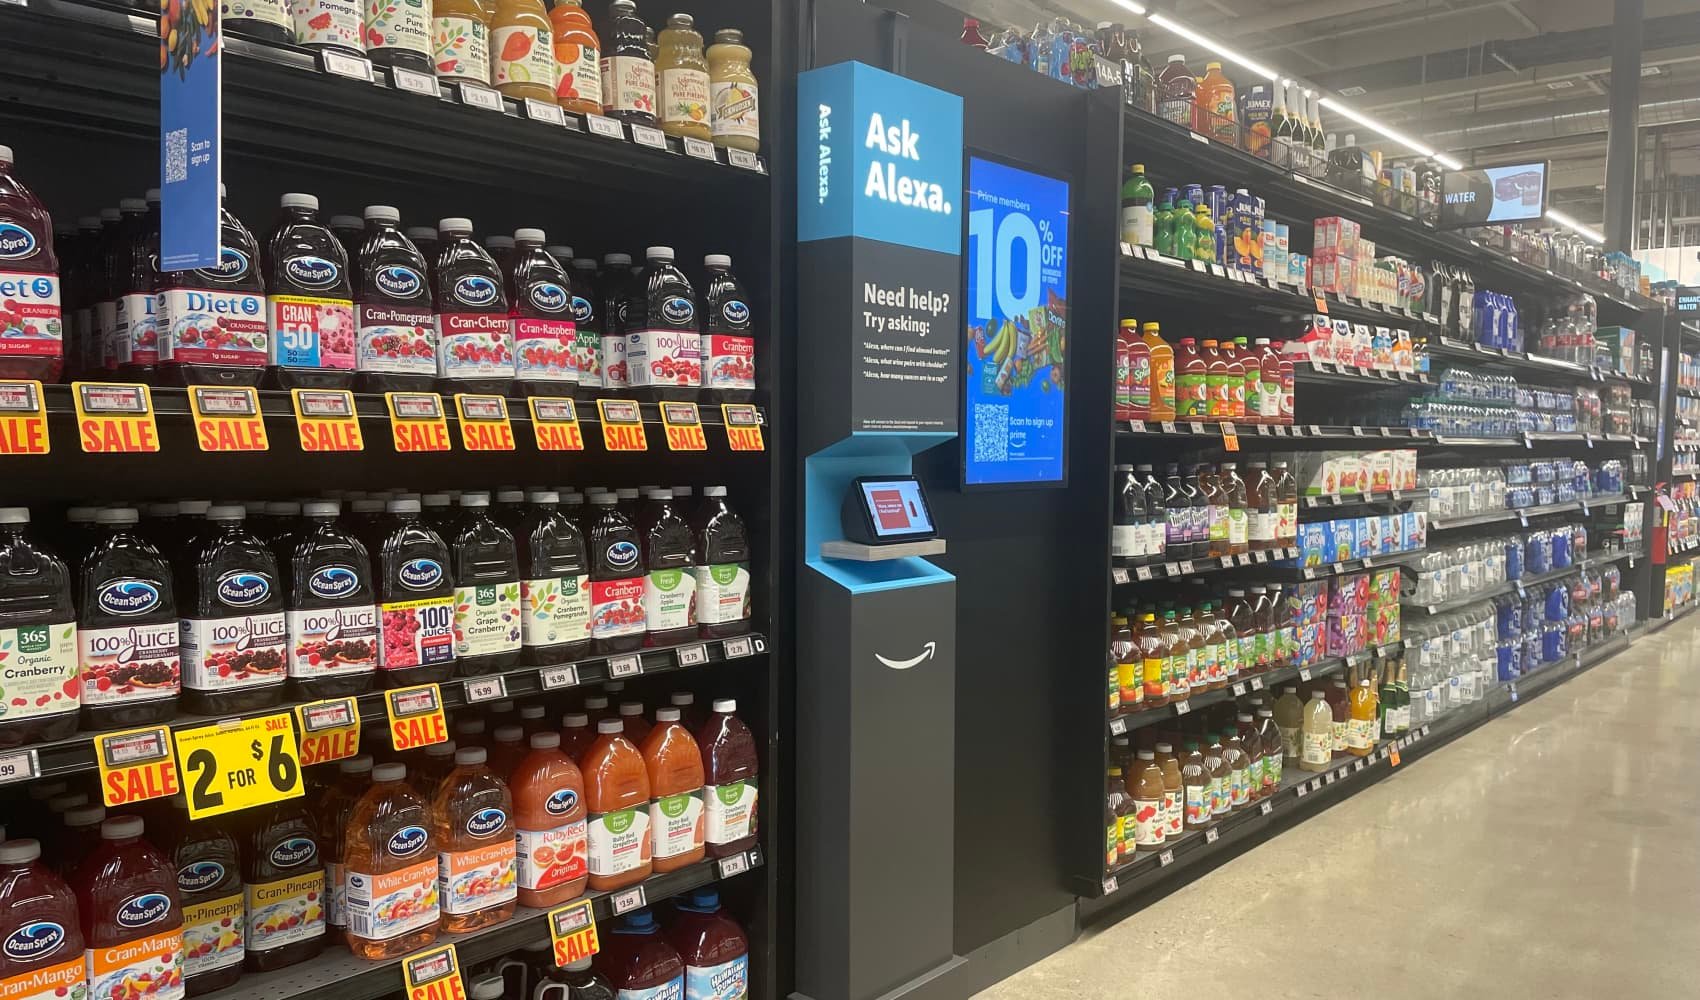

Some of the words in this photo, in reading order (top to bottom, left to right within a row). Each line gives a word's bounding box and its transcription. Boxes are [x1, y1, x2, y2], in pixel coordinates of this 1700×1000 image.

[319, 1, 364, 18] Pomegrana
[406, 17, 424, 28] Pure
[1247, 100, 1271, 109] JUMEX
[818, 103, 832, 141] Ask
[865, 112, 920, 160] Ask
[191, 141, 202, 153] Scan
[204, 141, 211, 150] to
[191, 154, 201, 167] sign
[202, 153, 210, 165] up
[818, 144, 832, 204] Alexa.
[864, 161, 952, 214] Alexa.
[977, 190, 998, 204] Prime
[998, 196, 1031, 212] members
[1444, 191, 1476, 204] WATER
[3, 237, 29, 250] Spray
[1042, 244, 1063, 267] OFF
[221, 258, 241, 270] Spray
[290, 263, 312, 279] Ocean
[312, 266, 333, 280] Spray
[968, 207, 1042, 323] 10
[1039, 218, 1054, 243] %
[379, 273, 398, 287] Ocean
[398, 278, 416, 290] Spray
[458, 284, 476, 297] Ocean
[476, 287, 492, 299] Spray
[864, 282, 905, 307] Need
[909, 287, 950, 316] help?
[186, 292, 239, 314] Diet
[1679, 296, 1700, 304] ENHANC
[1679, 303, 1697, 311] WATER
[282, 305, 312, 322] CRAN
[863, 311, 885, 333] Try
[887, 314, 930, 337] asking:
[283, 324, 313, 349] 50
[287, 350, 298, 358] 50
[1010, 416, 1025, 426] Scan
[1025, 416, 1032, 426] to
[1032, 416, 1045, 428] sign
[1045, 418, 1054, 428] up
[82, 420, 156, 452] SALE
[200, 421, 267, 450] SALE
[300, 422, 363, 451] SALE
[395, 424, 450, 451] SALE
[464, 424, 514, 451] SALE
[538, 425, 583, 451] SALE
[607, 426, 647, 451] SALE
[669, 427, 706, 450] SALE
[729, 427, 764, 451] SALE
[1010, 431, 1026, 440] prime
[403, 570, 421, 581] Ocean
[420, 568, 438, 581] Spray
[222, 585, 244, 598] Ocean
[244, 584, 264, 598] Spray
[313, 578, 333, 590] Ocean
[333, 577, 352, 590] Spray
[562, 579, 577, 590] 365
[104, 593, 129, 606] Ocean
[129, 592, 153, 606] Spray
[477, 588, 495, 599] 365
[605, 585, 642, 599] Cranberry
[660, 591, 685, 600] Cranberry
[475, 609, 497, 618] Organic
[553, 610, 588, 620] Pomegranate
[556, 605, 585, 614] Cranberry
[303, 617, 336, 631] 100%
[326, 608, 373, 641] JUICE
[468, 624, 506, 635] Cranberry
[476, 616, 499, 628] Grape
[20, 630, 47, 645] 365
[212, 626, 246, 641] 100%
[236, 617, 284, 651] JUICE
[421, 627, 451, 638] JUICE
[90, 638, 131, 652] 100%
[117, 628, 177, 664] JUICE
[755, 640, 765, 652] D
[17, 655, 52, 667] Organic
[4, 665, 65, 679] Cranberry
[549, 673, 566, 685] $6.99
[475, 686, 492, 697] $6.99
[265, 717, 288, 732] SALE
[393, 715, 447, 750] SALE
[300, 729, 357, 766] SALE
[107, 762, 178, 805] SALE
[187, 748, 224, 811] 2
[227, 768, 256, 789] FOR
[470, 819, 487, 830] Ocean
[487, 815, 502, 828] Spray
[612, 818, 628, 828] fresh
[391, 839, 408, 850] Ocean
[408, 834, 424, 848] Spray
[274, 850, 293, 861] Ocean
[293, 846, 311, 860] Spray
[456, 855, 480, 867] White
[750, 851, 757, 865] F
[178, 874, 199, 885] Ocean
[199, 868, 219, 885] Spray
[551, 862, 579, 878] Original
[378, 876, 402, 890] White
[121, 909, 143, 920] Ocean
[143, 902, 165, 918] Spray
[8, 939, 34, 950] Ocean
[34, 932, 57, 949] Spray
[555, 929, 596, 966] SALE
[711, 961, 746, 988] HAWAIIAN
[412, 975, 465, 1000] SALE
